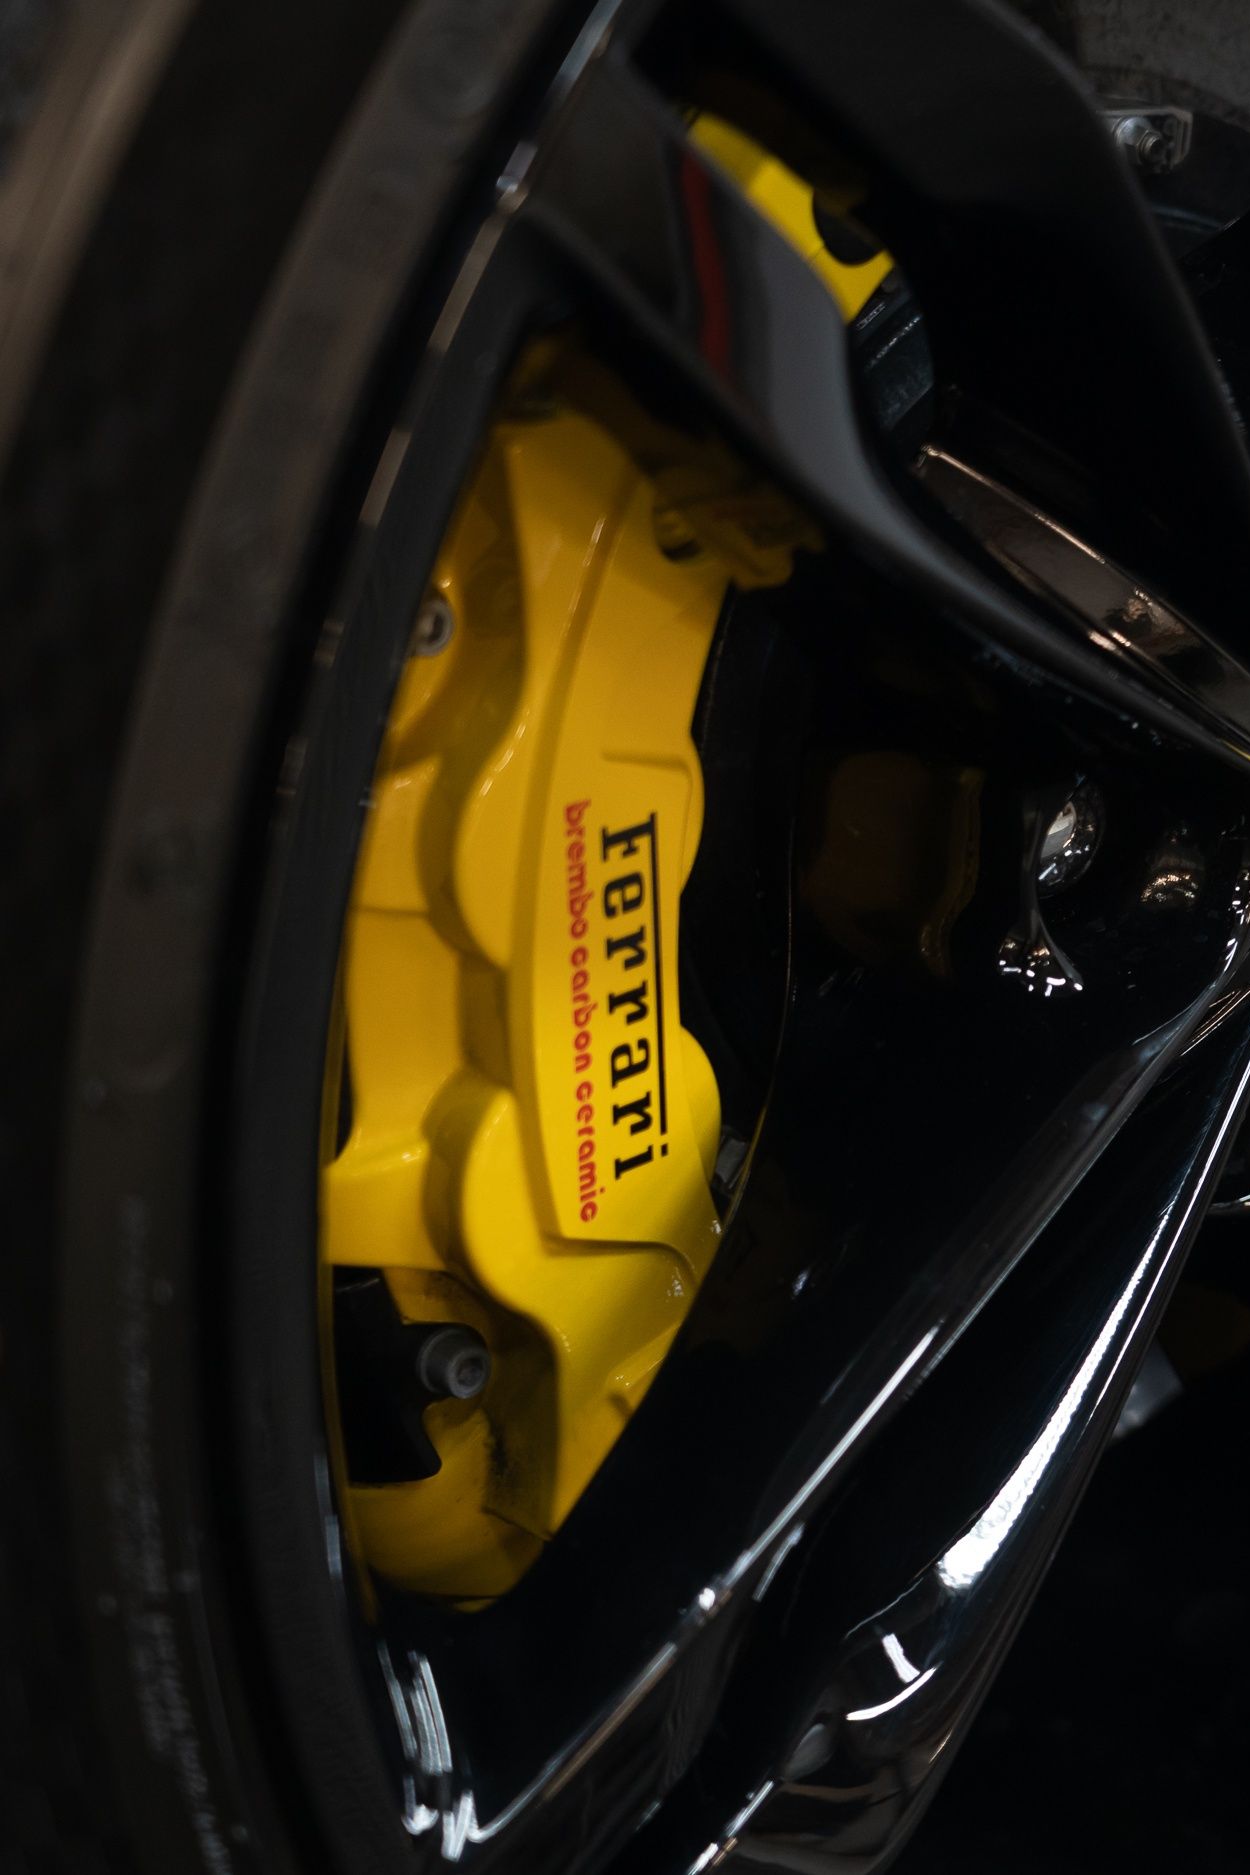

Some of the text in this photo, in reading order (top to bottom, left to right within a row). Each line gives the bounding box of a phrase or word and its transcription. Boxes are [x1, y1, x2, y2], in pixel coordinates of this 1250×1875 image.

[565, 799, 605, 1223] brembo carbon ceramic
[602, 812, 668, 1180] Ferrari
